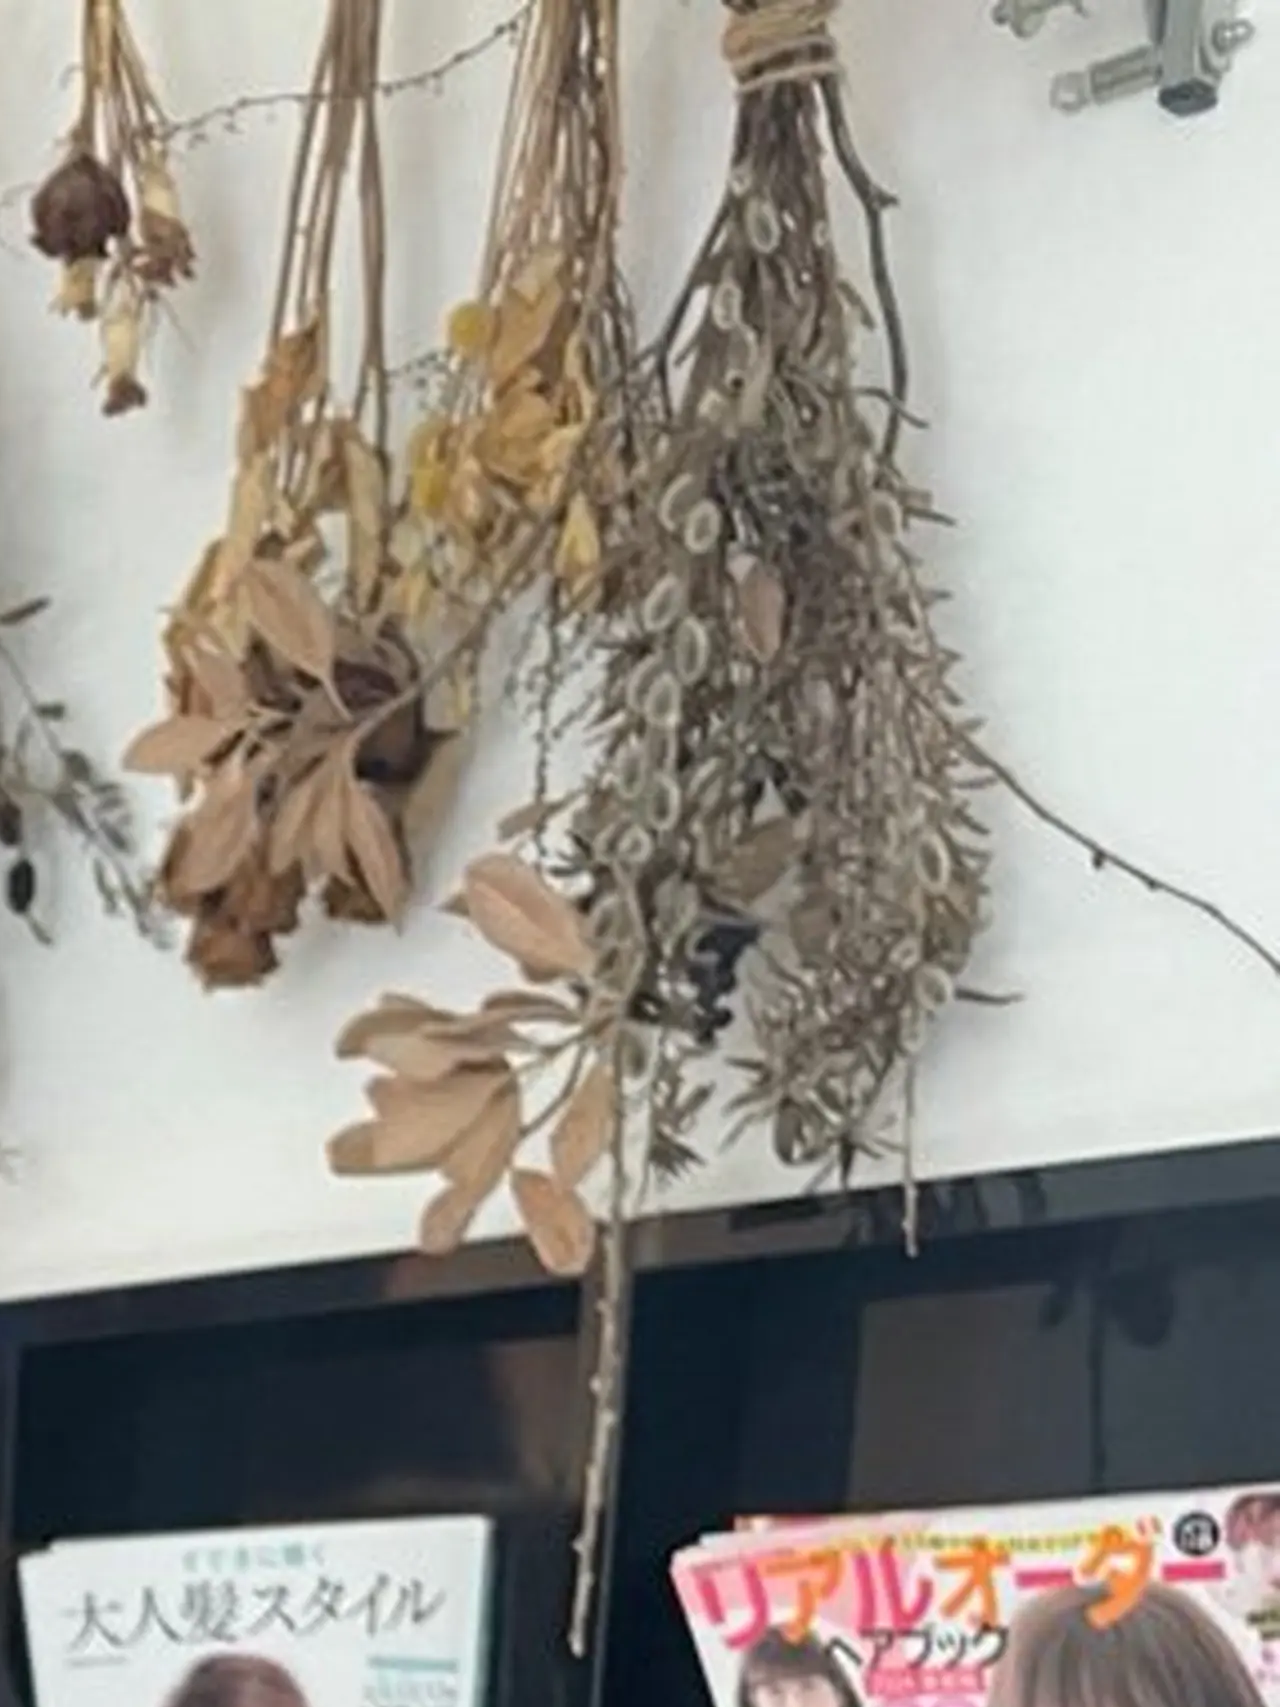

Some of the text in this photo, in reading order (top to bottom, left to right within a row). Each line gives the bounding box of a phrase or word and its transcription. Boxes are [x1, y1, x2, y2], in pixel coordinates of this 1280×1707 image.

[62, 1572, 446, 1652] 大人髪スタイル
[694, 1517, 1227, 1650] リアルオーダー
